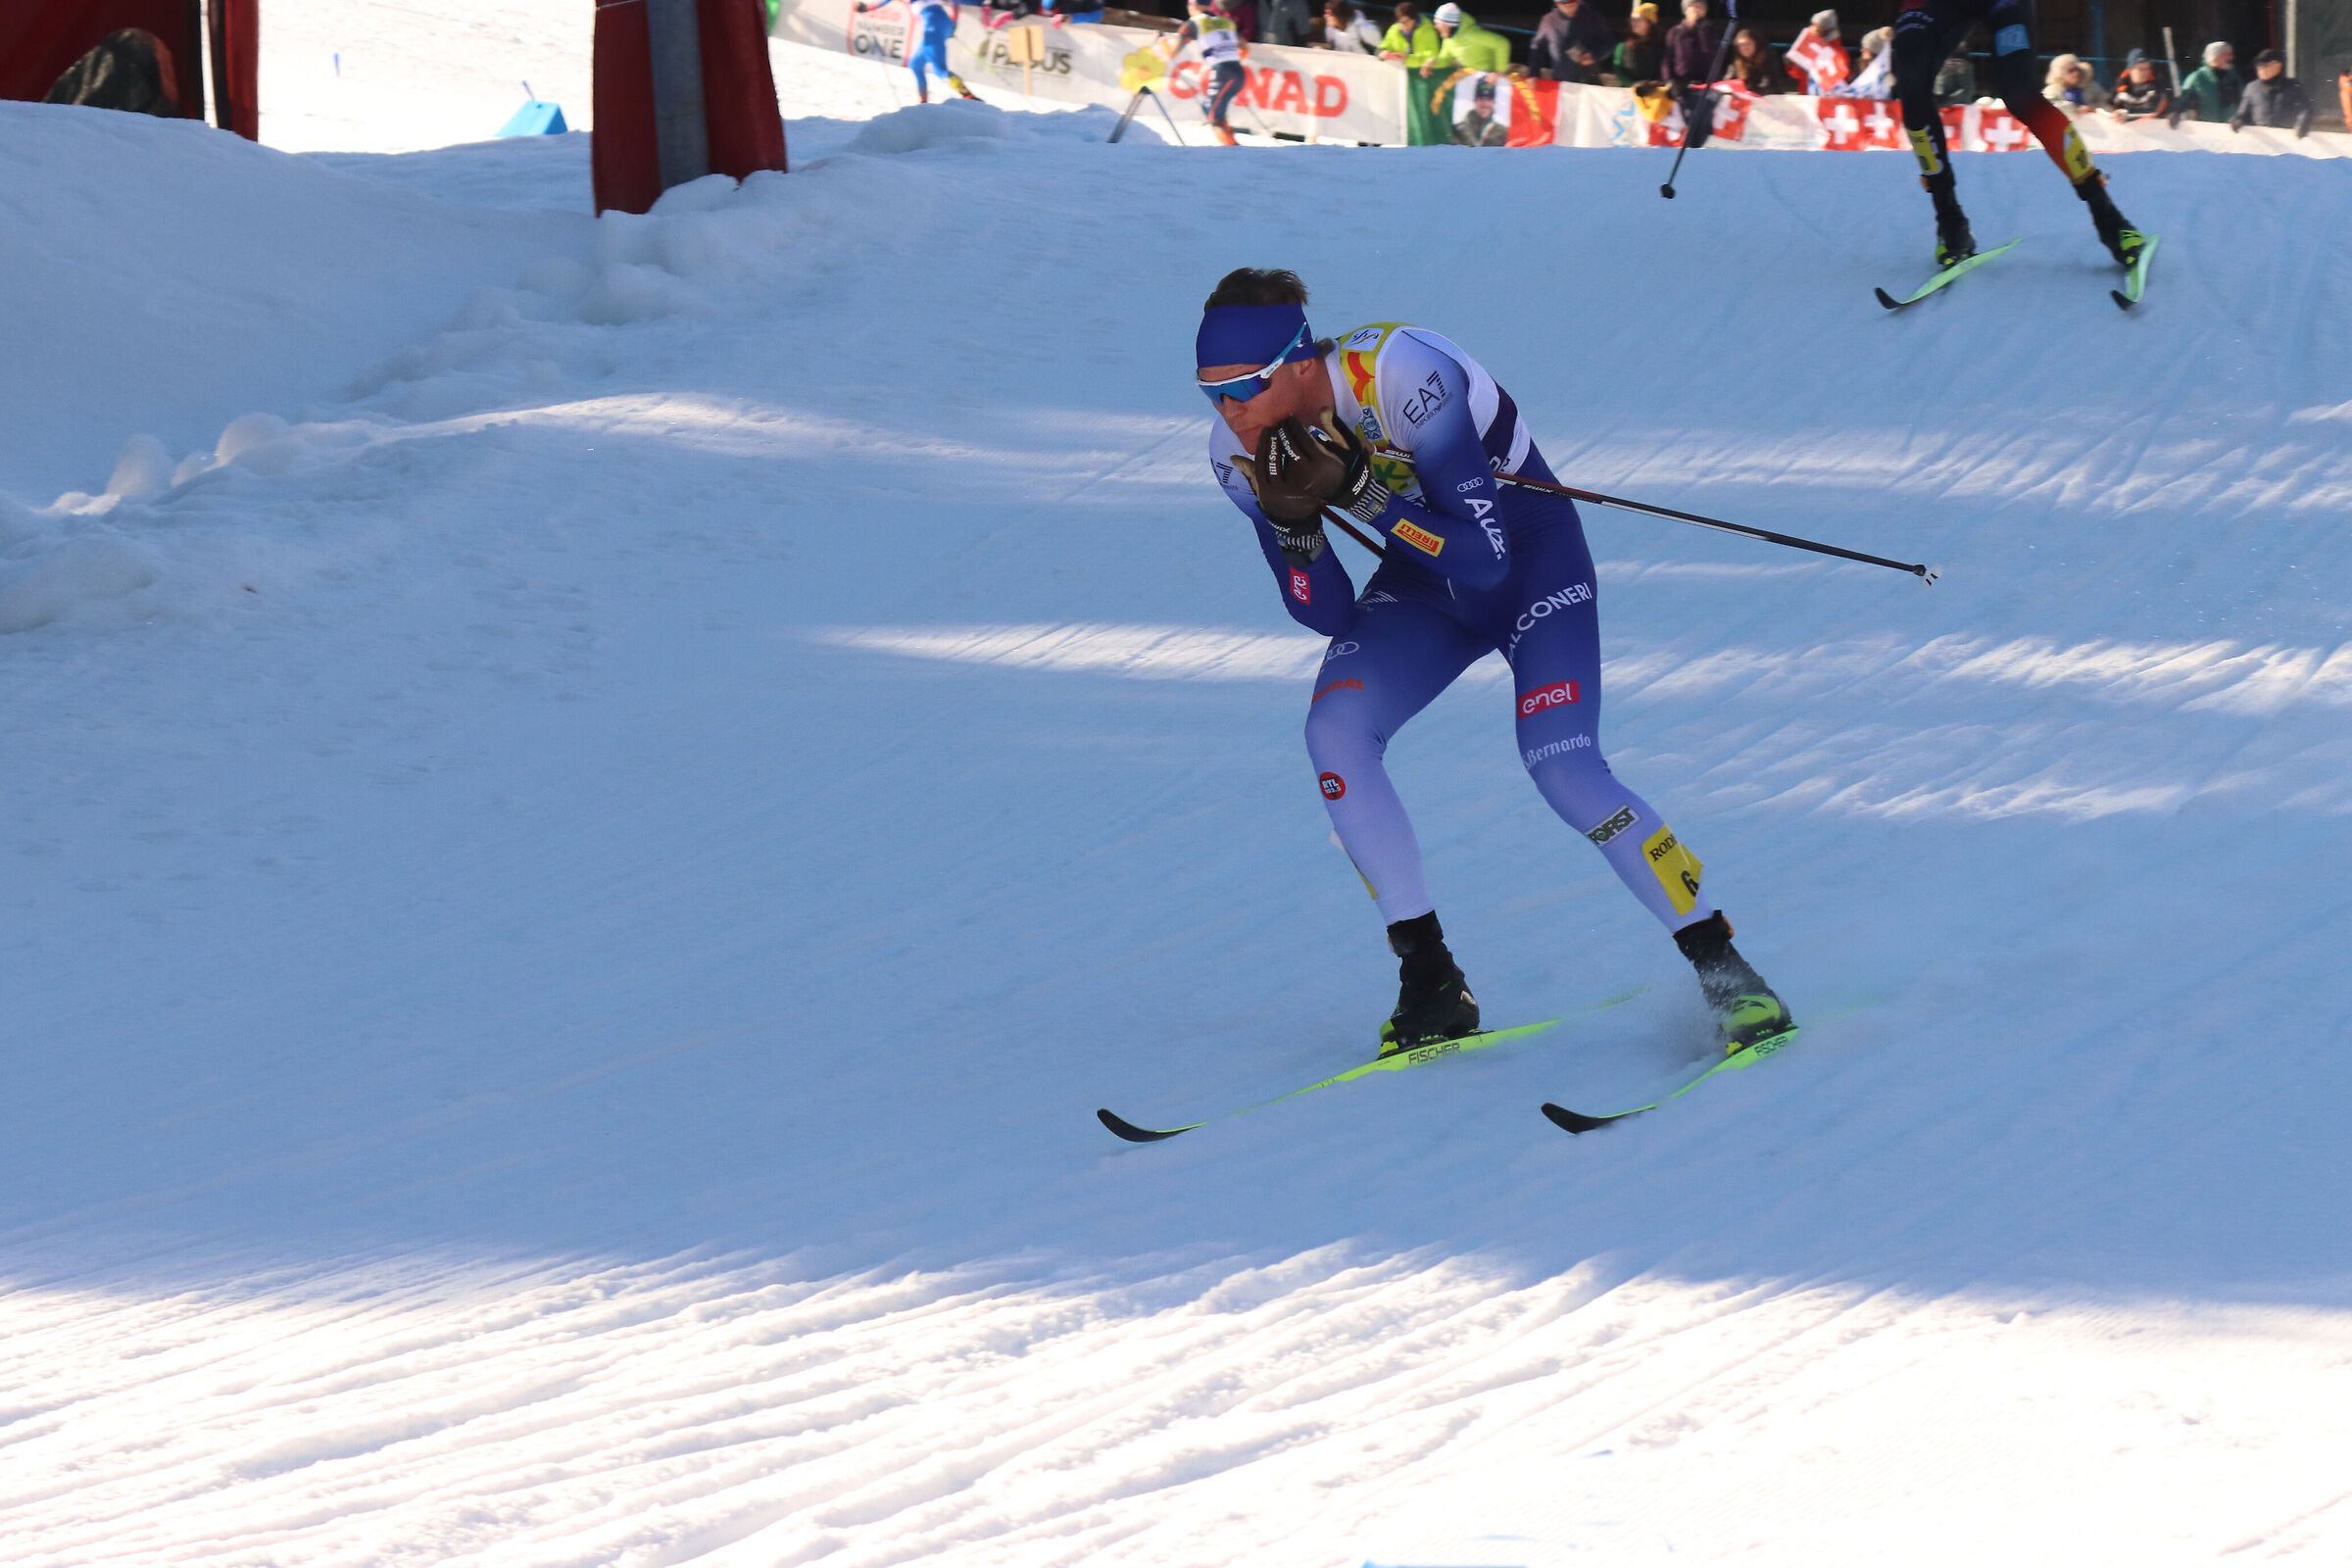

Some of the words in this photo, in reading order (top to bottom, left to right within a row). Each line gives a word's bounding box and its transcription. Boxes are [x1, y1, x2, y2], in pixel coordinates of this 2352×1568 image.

[854, 34, 903, 59] ONE
[1169, 60, 1348, 118] CNAD
[1396, 523, 1440, 553] PIRELLI
[1508, 582, 1592, 666] ALCONERI
[1522, 683, 1573, 714] enel
[1408, 1042, 1461, 1065] FISCHER
